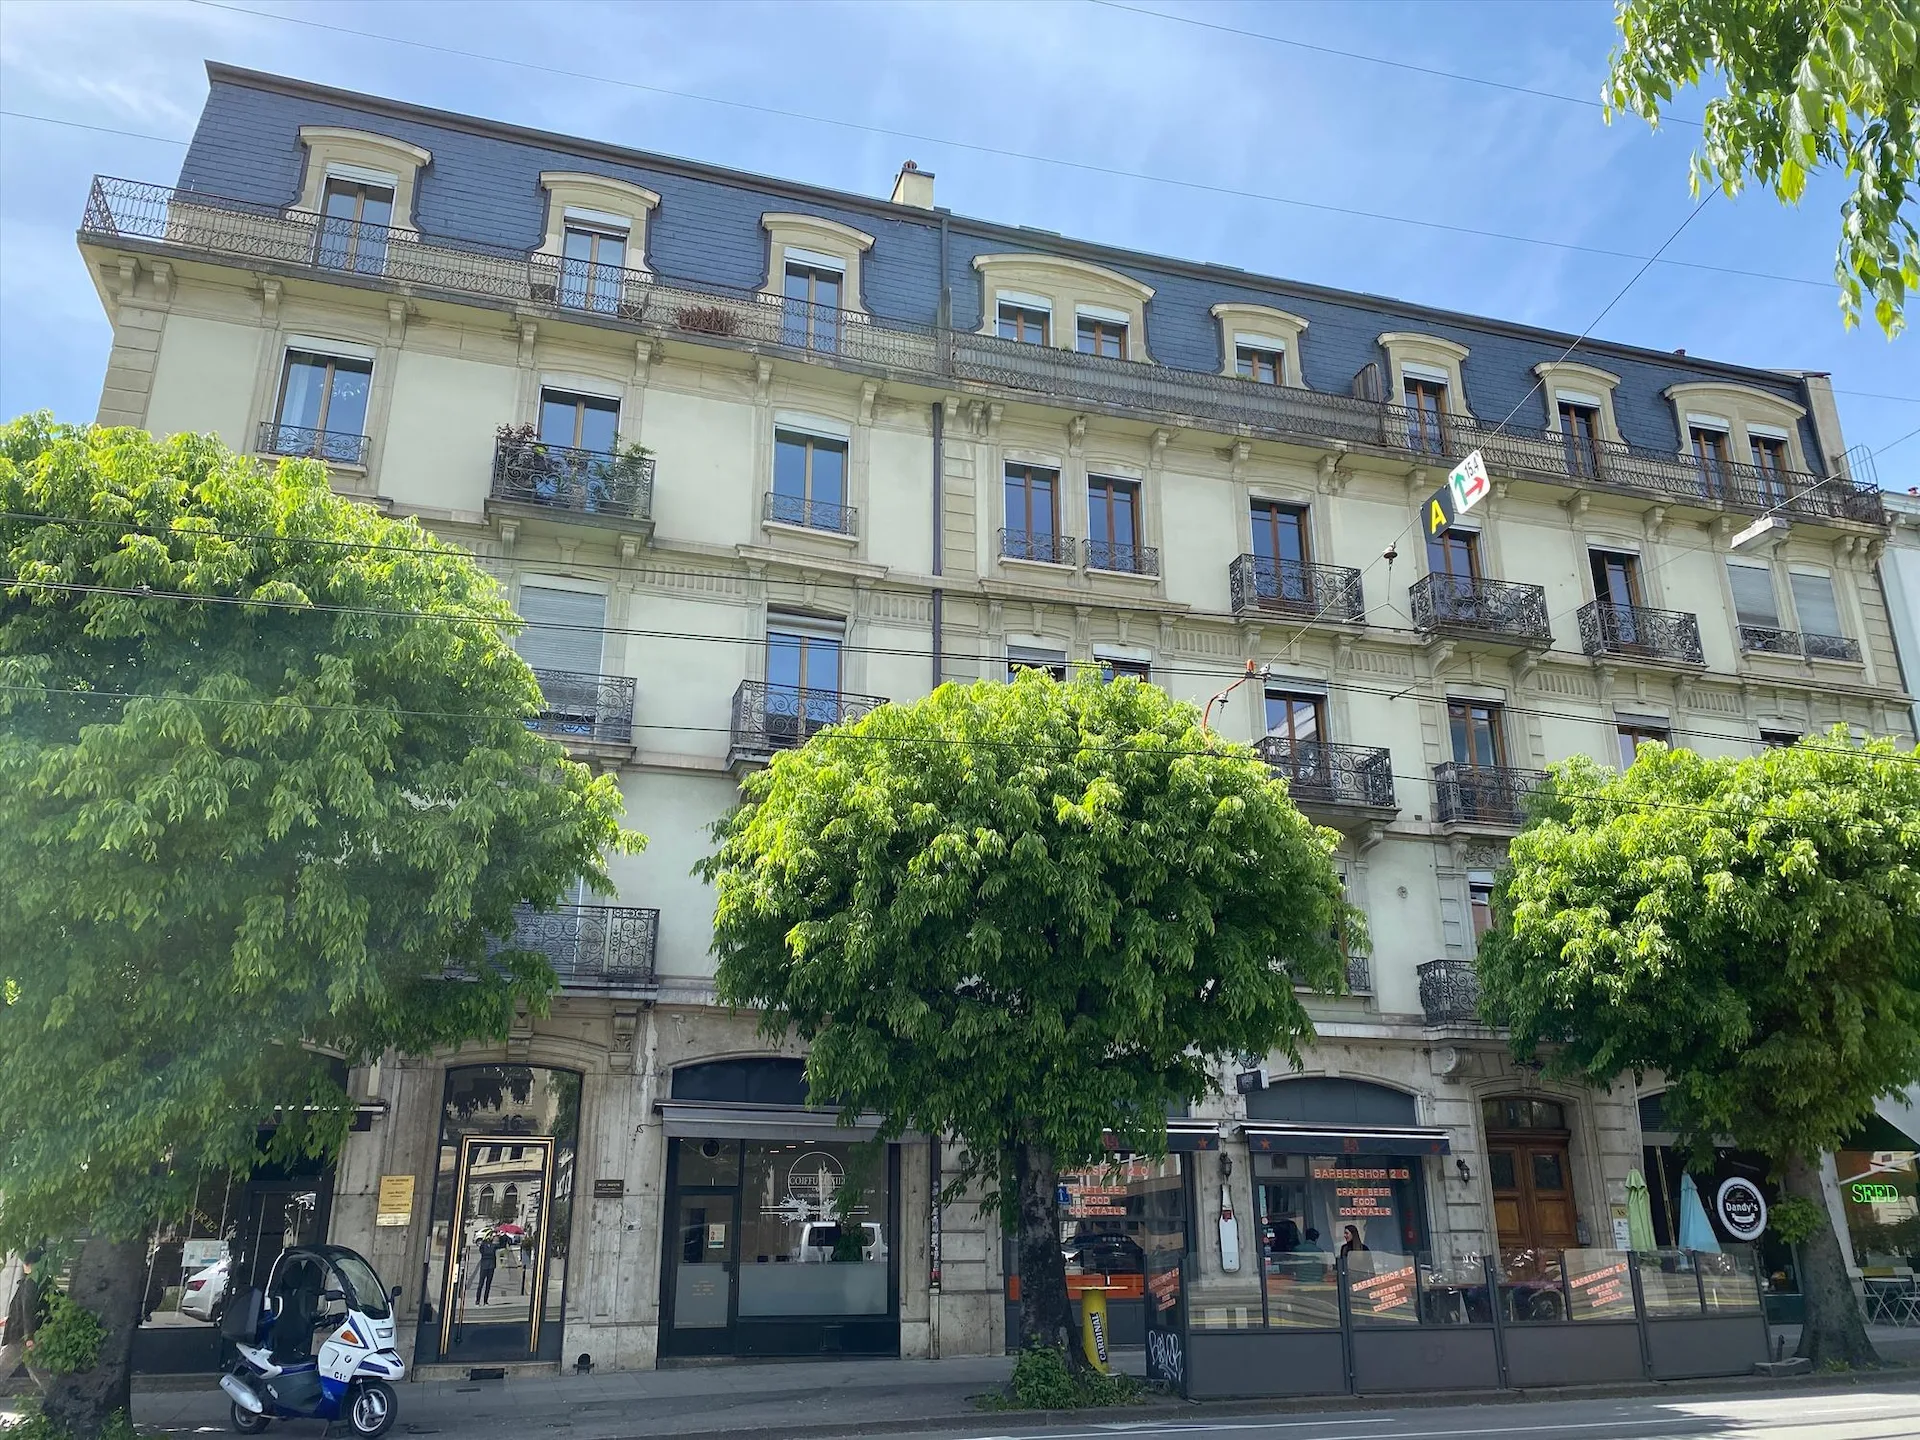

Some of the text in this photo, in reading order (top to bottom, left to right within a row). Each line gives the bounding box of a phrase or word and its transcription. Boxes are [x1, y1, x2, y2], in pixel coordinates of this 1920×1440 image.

[1430, 499, 1447, 535] A
[1314, 1168, 1386, 1179] BARBERSHOP
[1336, 1187, 1391, 1196] CRAFT BEER
[1851, 1183, 1899, 1203] SEED
[1085, 1196, 1110, 1205] FOOD
[1352, 1197, 1377, 1206] FOOD
[1068, 1206, 1127, 1216] COCKTAILS
[1339, 1207, 1392, 1216] COCKTAILS
[1725, 1202, 1759, 1213] Dandy's
[1352, 1270, 1399, 1292] BARBERSHOP
[1091, 1312, 1107, 1361] CARDINAL
